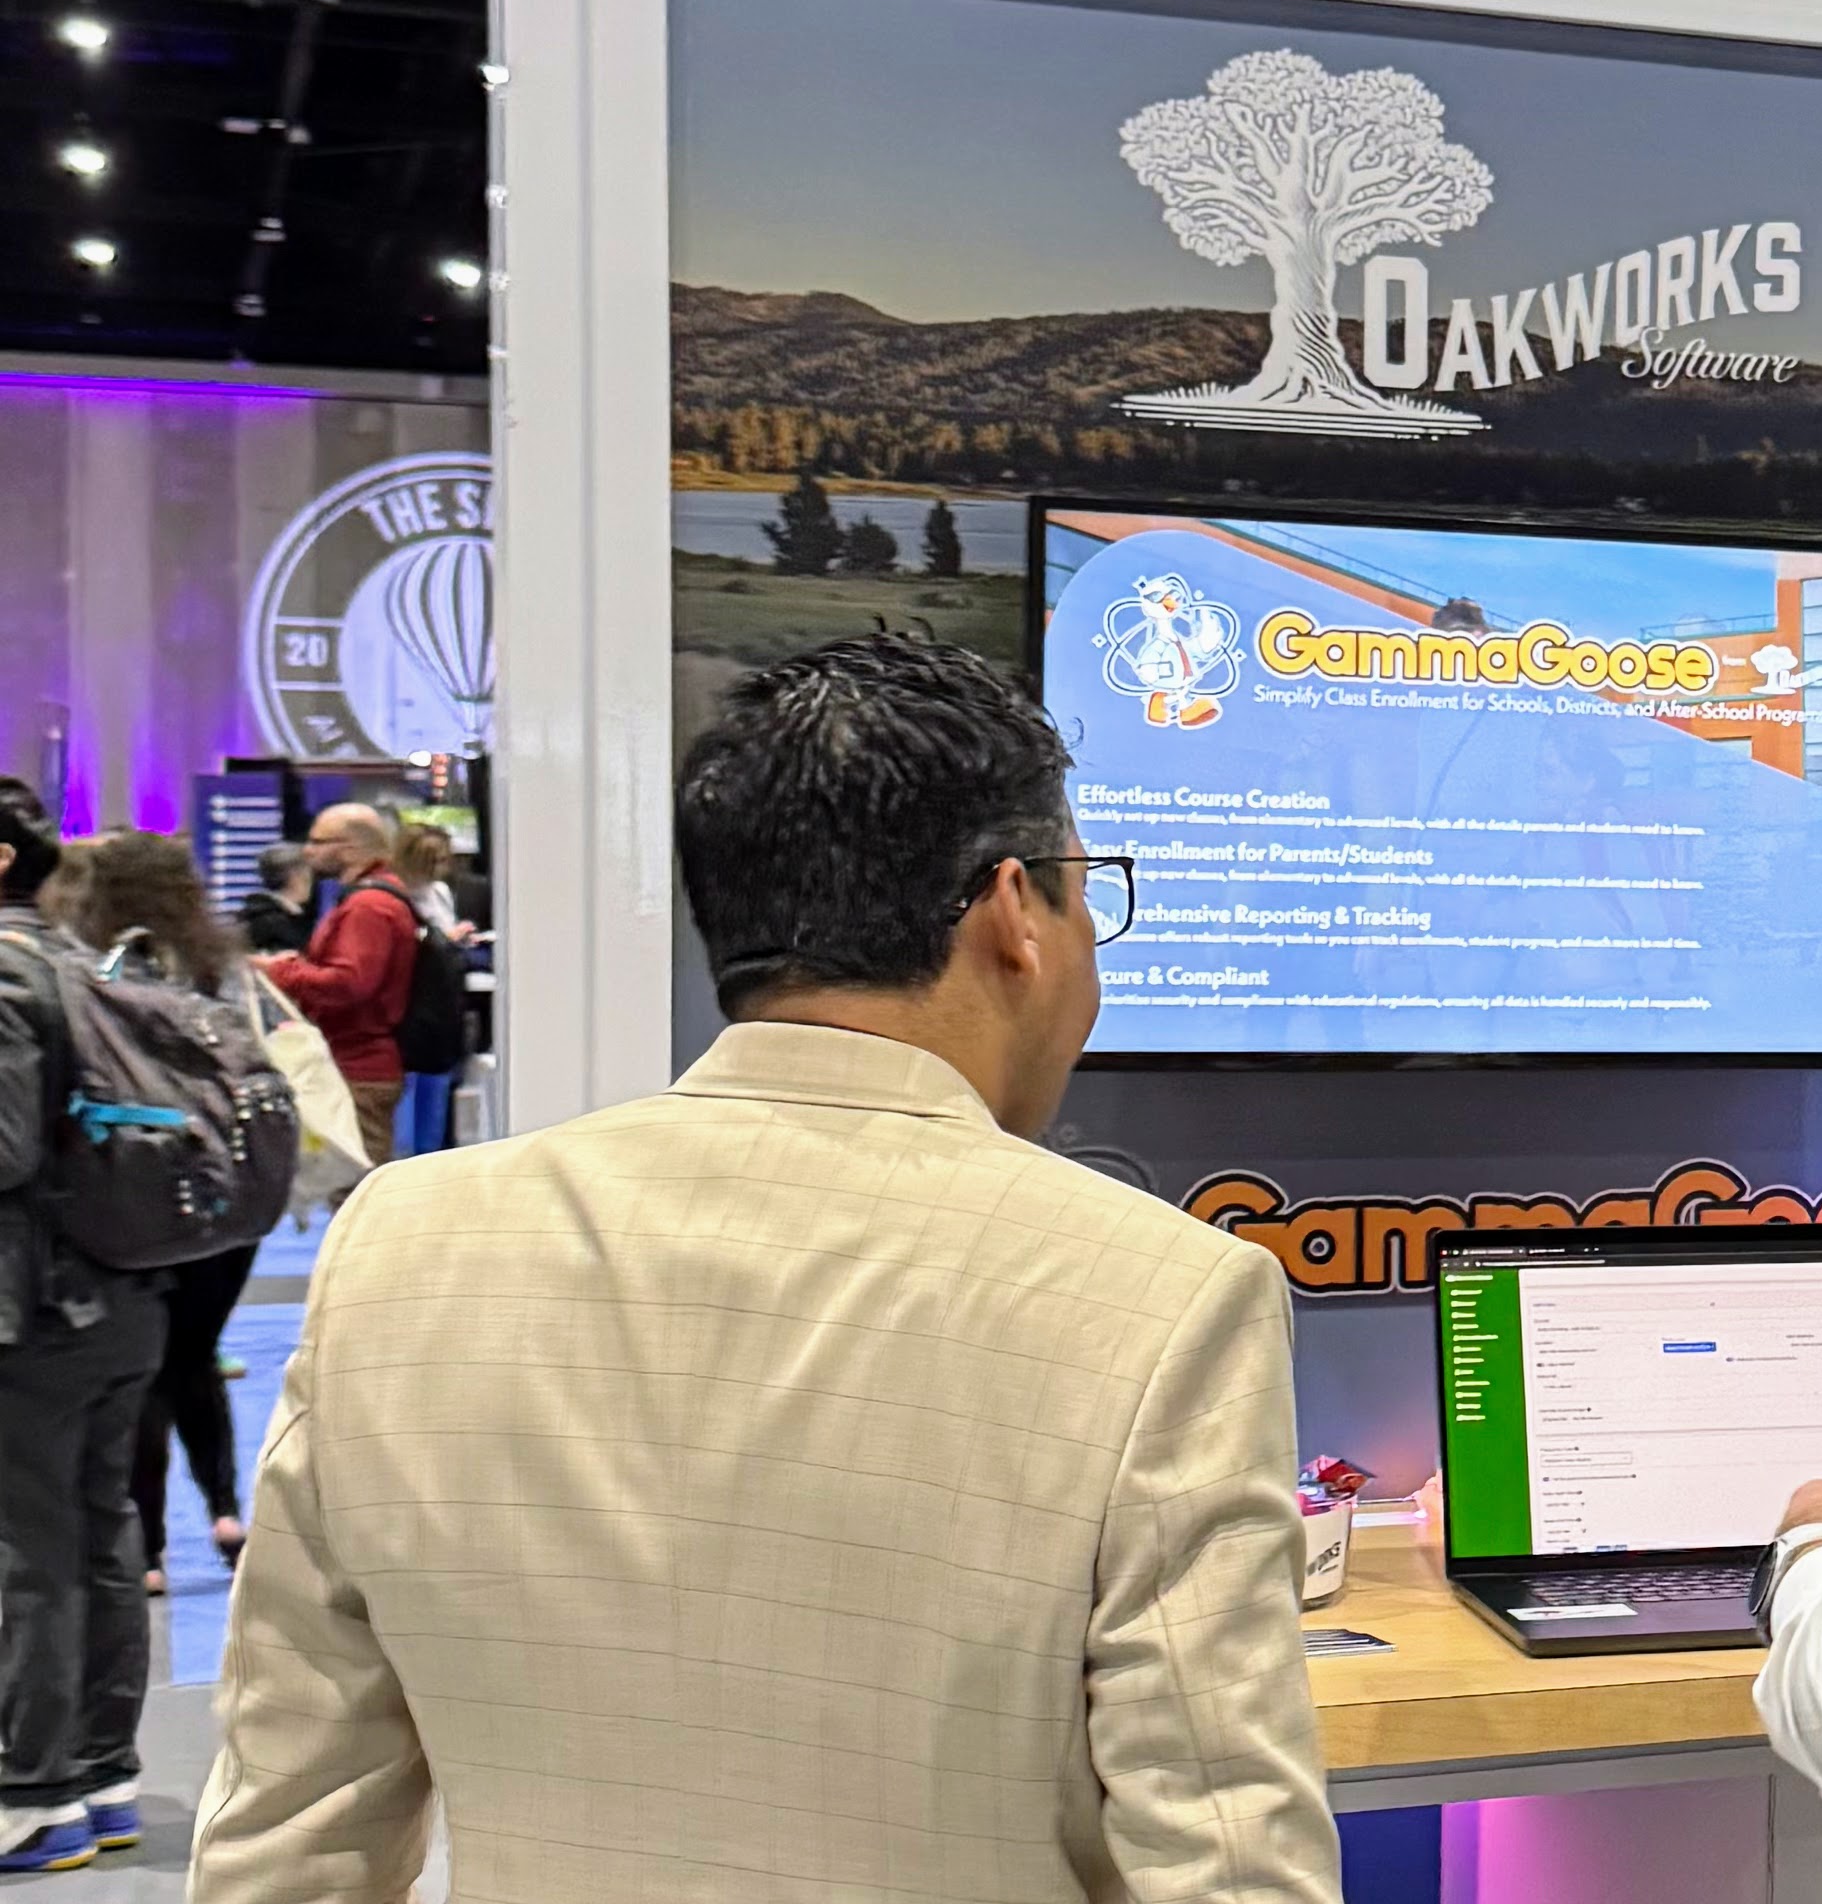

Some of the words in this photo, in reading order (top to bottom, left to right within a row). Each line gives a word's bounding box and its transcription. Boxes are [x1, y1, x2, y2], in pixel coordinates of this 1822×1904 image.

[1362, 221, 1802, 393] OAKWORKS
[1621, 325, 1799, 390] Software
[360, 481, 448, 544] THE
[453, 480, 492, 531] S
[284, 633, 328, 667] 20
[1256, 608, 1717, 693] GammaGoose
[1253, 683, 1322, 709] Simplify
[1325, 688, 1367, 708] Class
[1370, 688, 1458, 710] Enrollment
[1462, 692, 1484, 710] for
[1488, 693, 1554, 715] Schools,
[1556, 697, 1621, 718] Districts,
[1624, 701, 1651, 717] and
[1656, 700, 1755, 721] After-School
[1077, 784, 1171, 806] Effortless
[1174, 787, 1243, 808] Course
[1246, 789, 1331, 810] Creation
[1125, 840, 1236, 861] Enrollment
[1237, 842, 1267, 861] for
[1269, 843, 1434, 866] Parents/Students
[1131, 902, 1232, 924] rehensive
[1234, 904, 1331, 929] Reporting
[1334, 906, 1350, 925] &
[1352, 906, 1431, 931] Tracking
[1100, 969, 1145, 985] cure
[1147, 965, 1164, 985] &
[1166, 965, 1270, 990] Compliant
